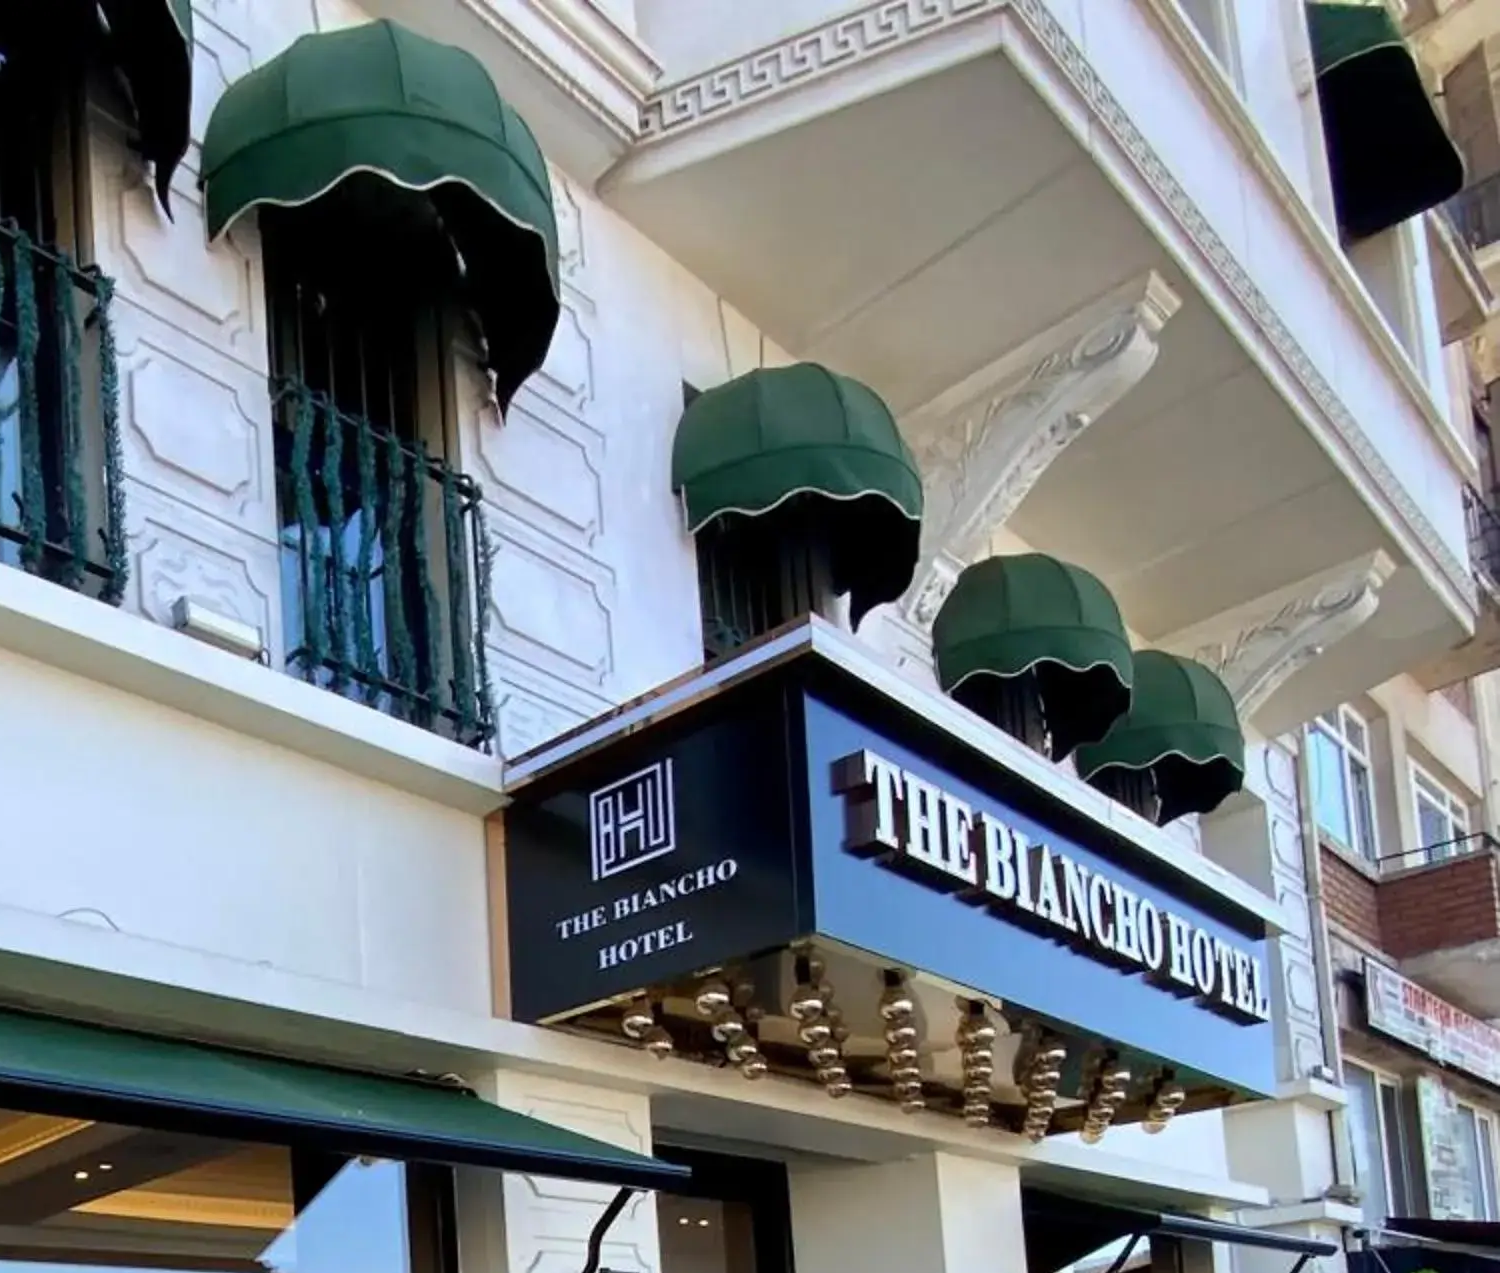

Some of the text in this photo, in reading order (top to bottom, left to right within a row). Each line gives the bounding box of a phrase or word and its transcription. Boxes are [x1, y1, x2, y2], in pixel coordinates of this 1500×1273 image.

[555, 858, 739, 940] THE BIANCHO
[864, 748, 1269, 1023] THE BIANCHO HOTEL
[598, 920, 694, 970] HOTEL
